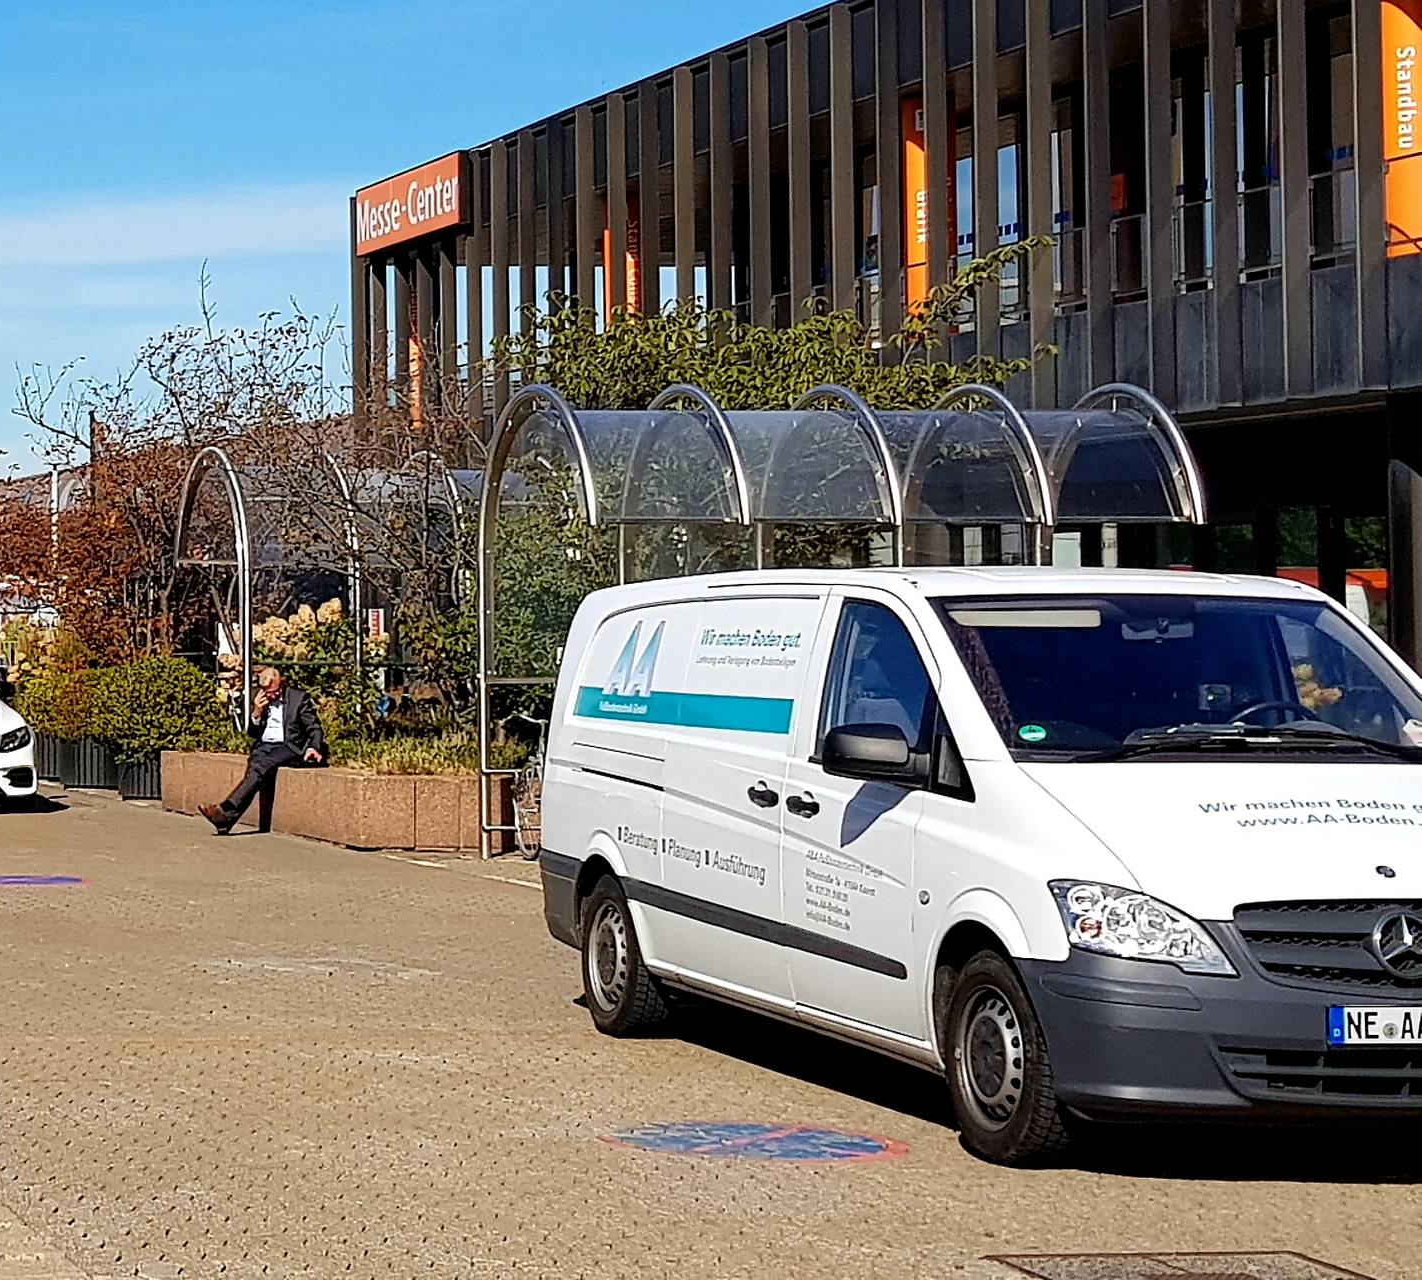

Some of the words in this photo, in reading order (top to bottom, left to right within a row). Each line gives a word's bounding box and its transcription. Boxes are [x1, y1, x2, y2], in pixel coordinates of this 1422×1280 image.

[1396, 46, 1418, 149] Standbau
[357, 175, 459, 244] Messe-Center
[701, 629, 717, 646] Wir
[716, 629, 751, 647] machen
[751, 629, 782, 647] Boden
[1198, 801, 1236, 814] Wir
[1245, 799, 1331, 811] machen
[1336, 799, 1407, 811] Boden
[623, 826, 658, 856] Beratung
[668, 838, 701, 868] Planung
[712, 850, 766, 886] Ausführung
[1347, 1011, 1380, 1039] NE
